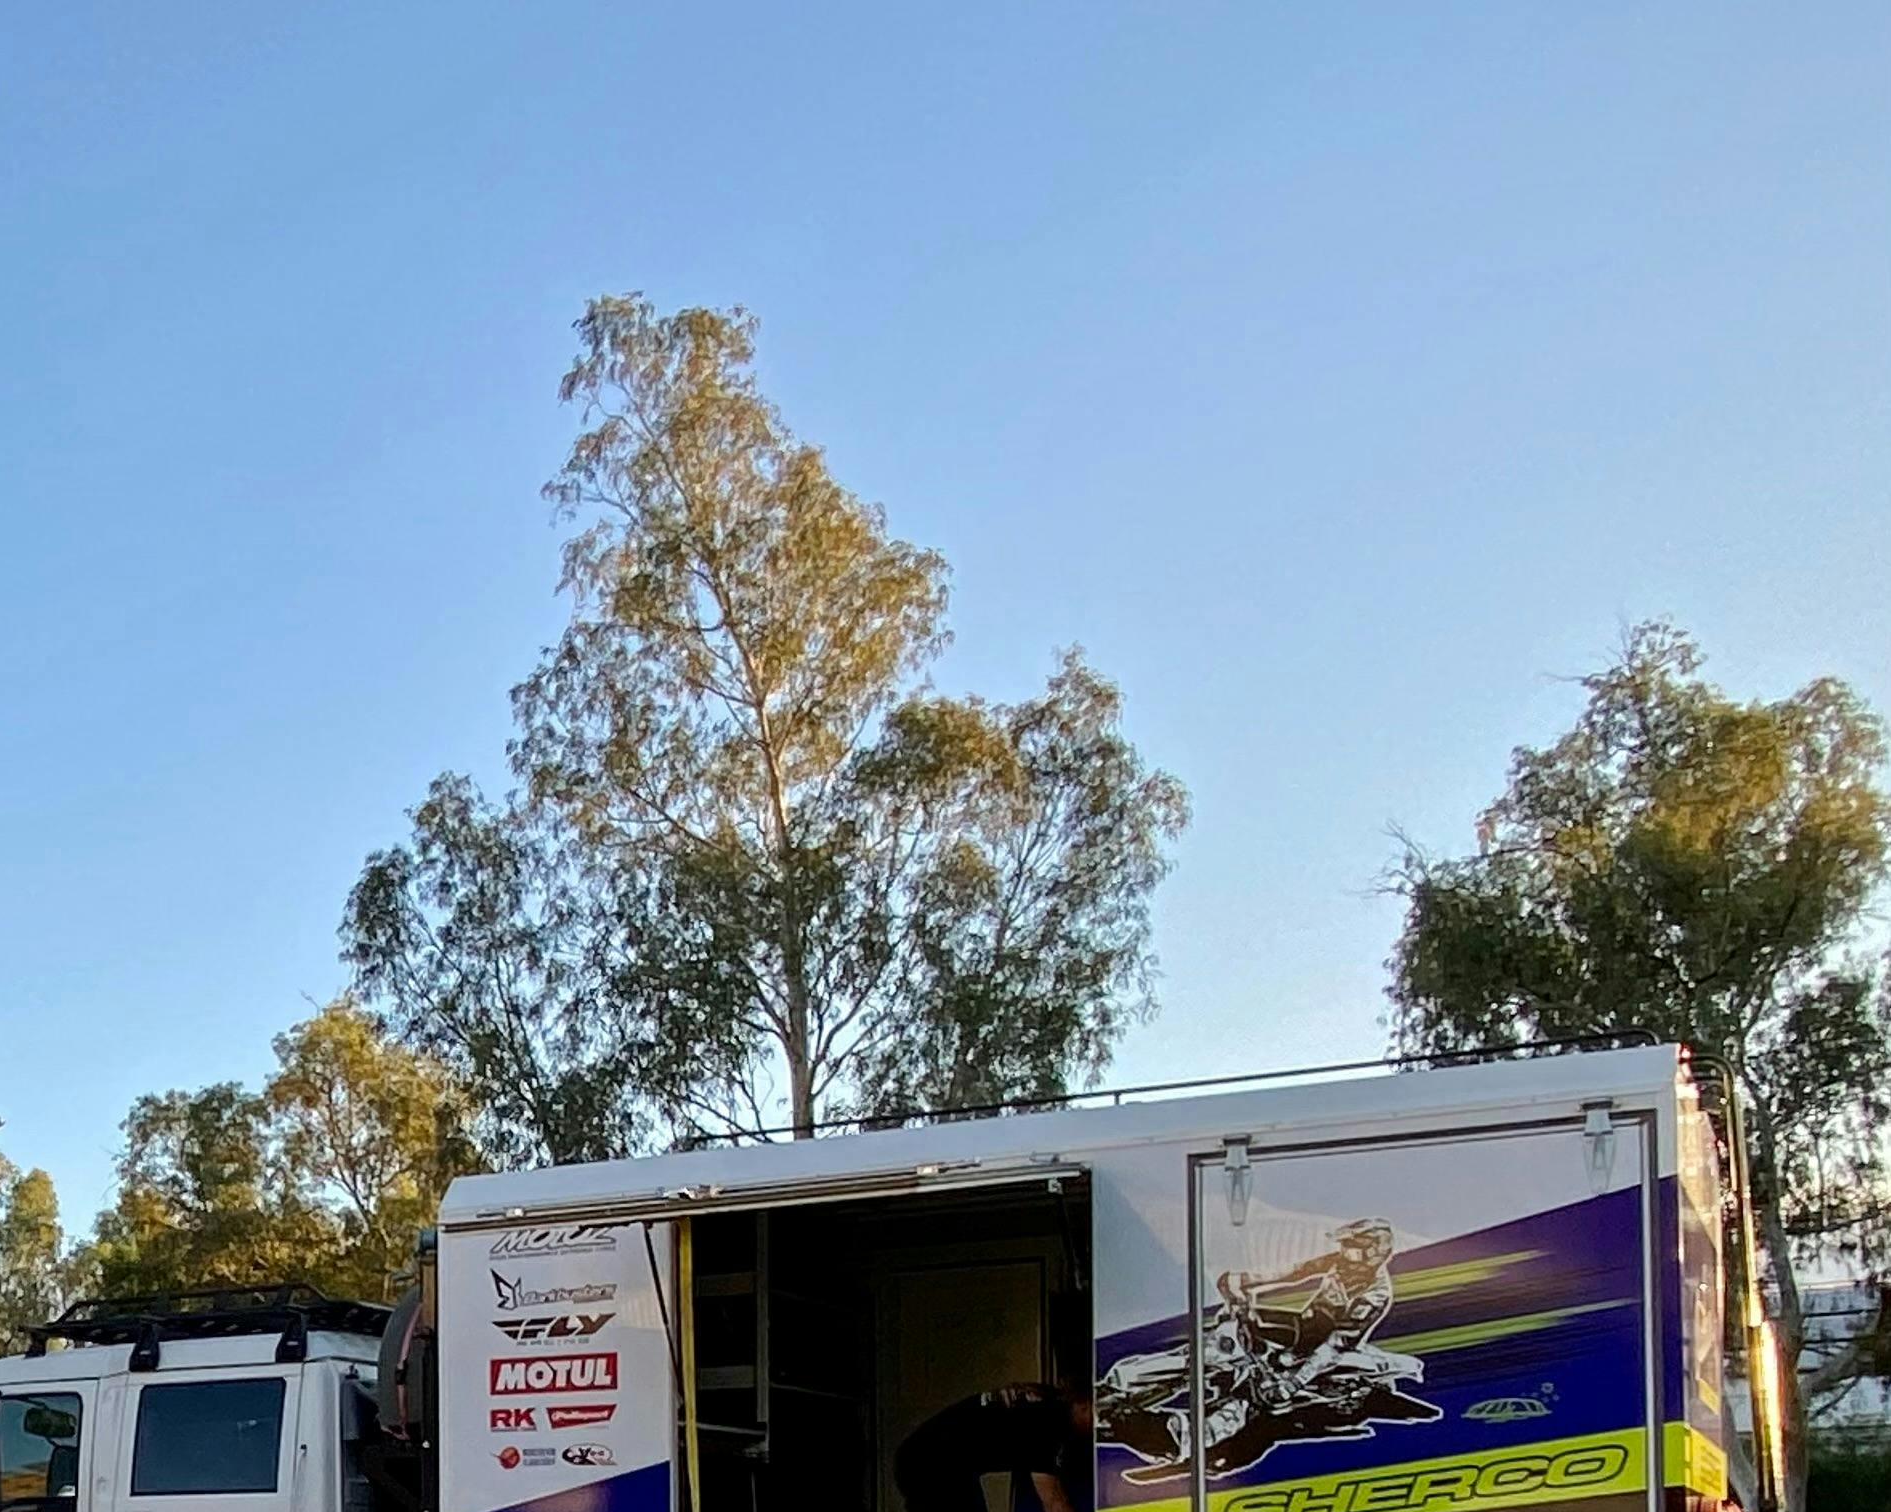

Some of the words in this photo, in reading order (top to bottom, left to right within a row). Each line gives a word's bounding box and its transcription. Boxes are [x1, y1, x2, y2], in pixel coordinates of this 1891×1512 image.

[491, 1312, 617, 1340] FLY
[495, 1357, 612, 1391] MOTUL
[490, 1407, 536, 1428] RK
